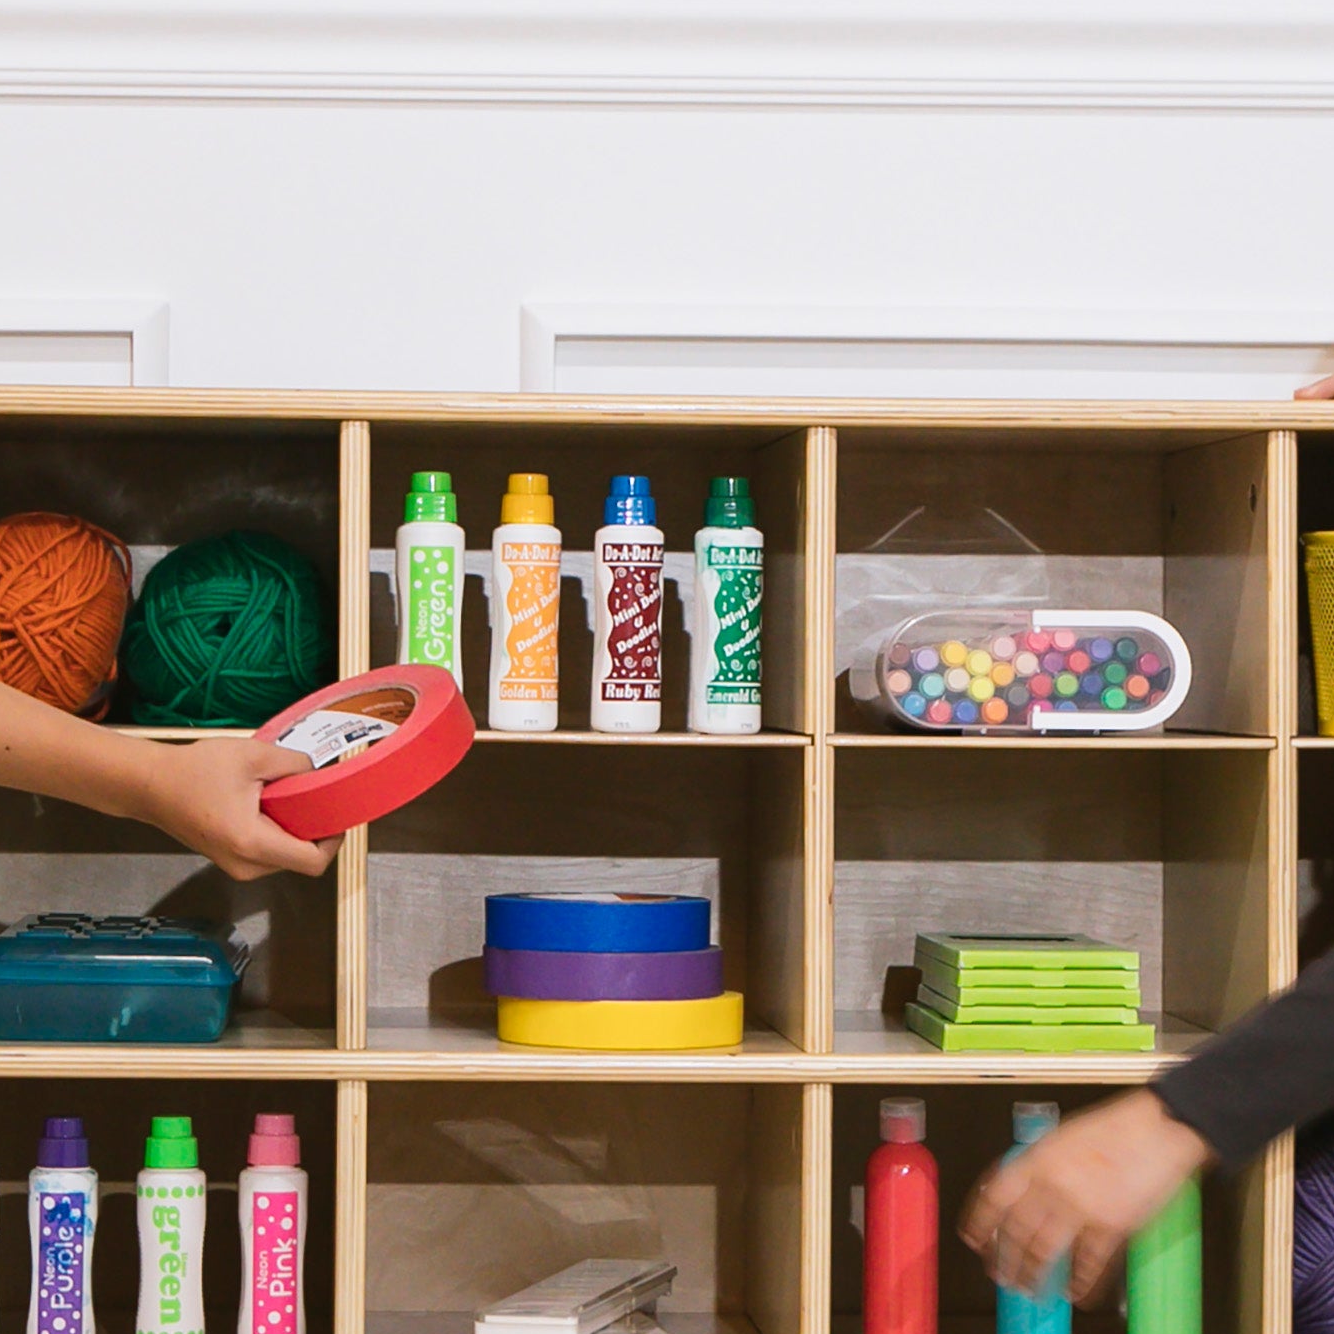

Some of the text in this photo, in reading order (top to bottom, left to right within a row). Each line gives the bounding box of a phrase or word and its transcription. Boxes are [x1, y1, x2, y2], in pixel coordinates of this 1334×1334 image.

[415, 599, 428, 639] Neon
[423, 579, 446, 661] Green
[512, 601, 540, 627] Mini
[613, 601, 641, 627] Mini
[720, 604, 747, 630] Mini
[500, 683, 538, 699] Golden
[605, 683, 642, 702] Ruby
[707, 687, 750, 703] Emerald
[43, 1247, 56, 1286] Neon
[50, 1226, 79, 1309] Purple
[152, 1205, 181, 1325] green
[256, 1250, 268, 1289] Neon
[269, 1237, 293, 1297] Pink
